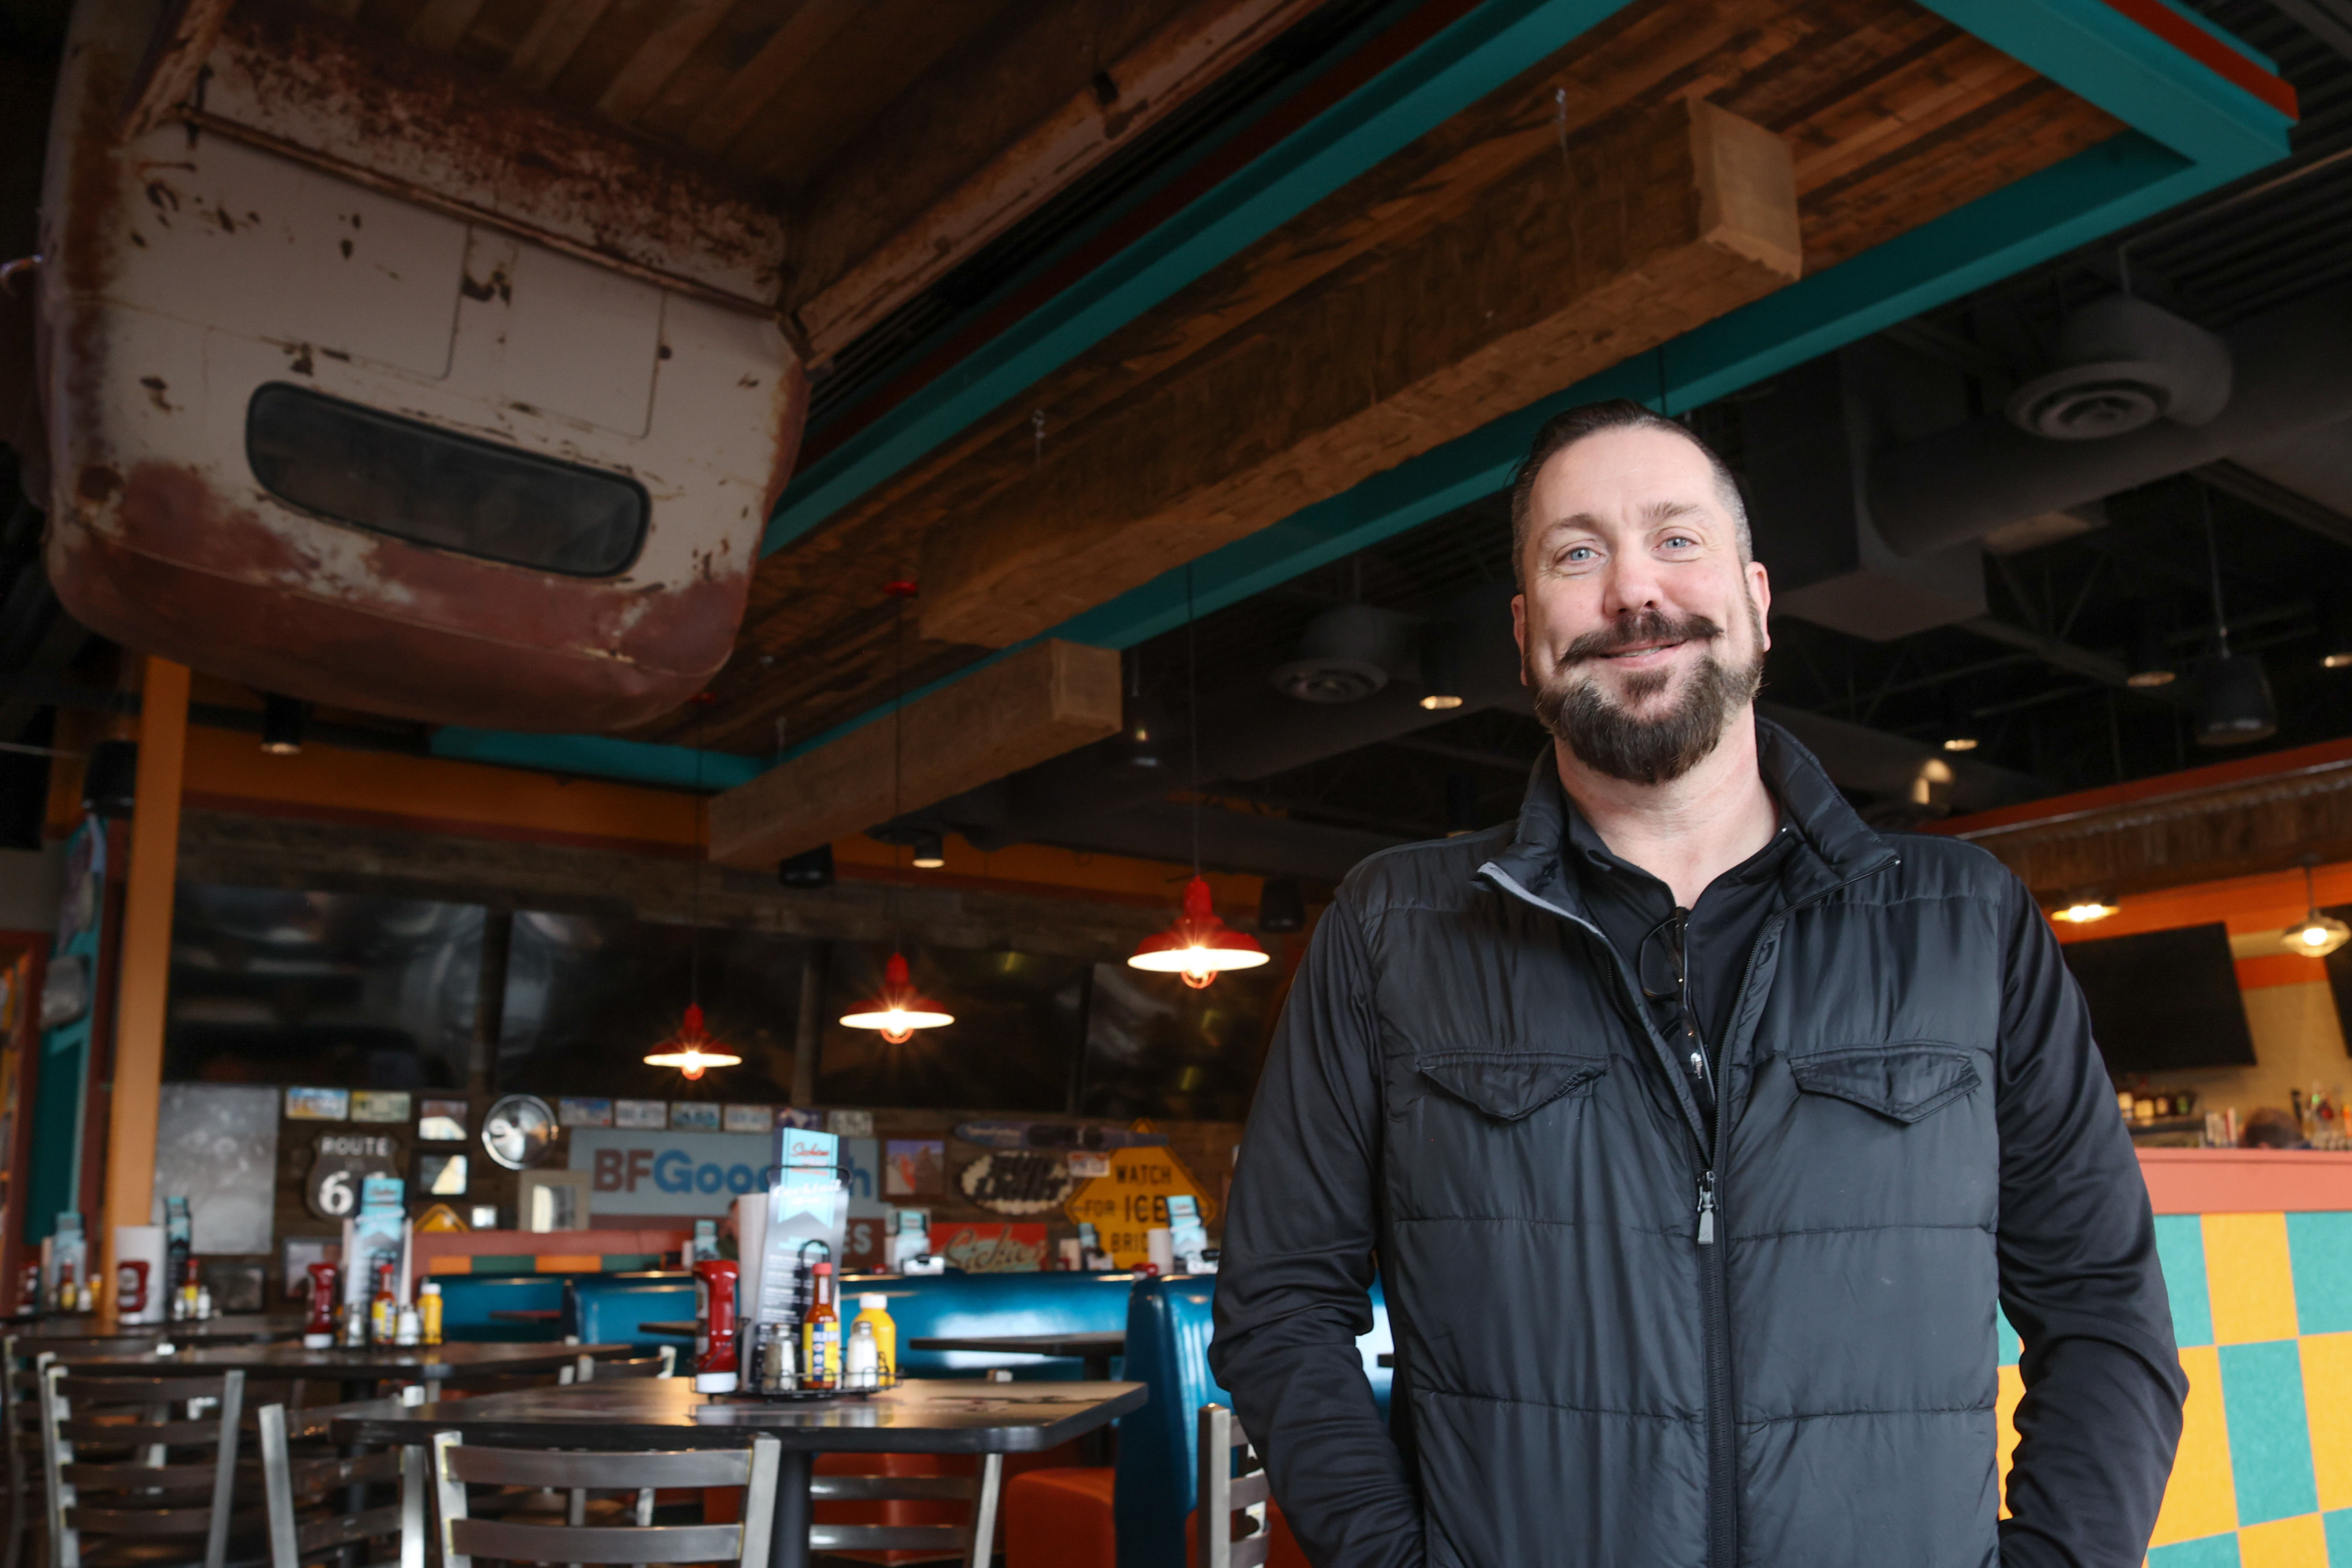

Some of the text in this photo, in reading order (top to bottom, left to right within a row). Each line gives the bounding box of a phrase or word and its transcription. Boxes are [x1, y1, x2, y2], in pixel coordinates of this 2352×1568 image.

[322, 1136, 390, 1156] ROUTE
[593, 1148, 871, 1197] BFGooh
[1116, 1165, 1172, 1185] WATCH
[1085, 1195, 1167, 1223] FOR ICE
[1111, 1232, 1148, 1253] BRI
